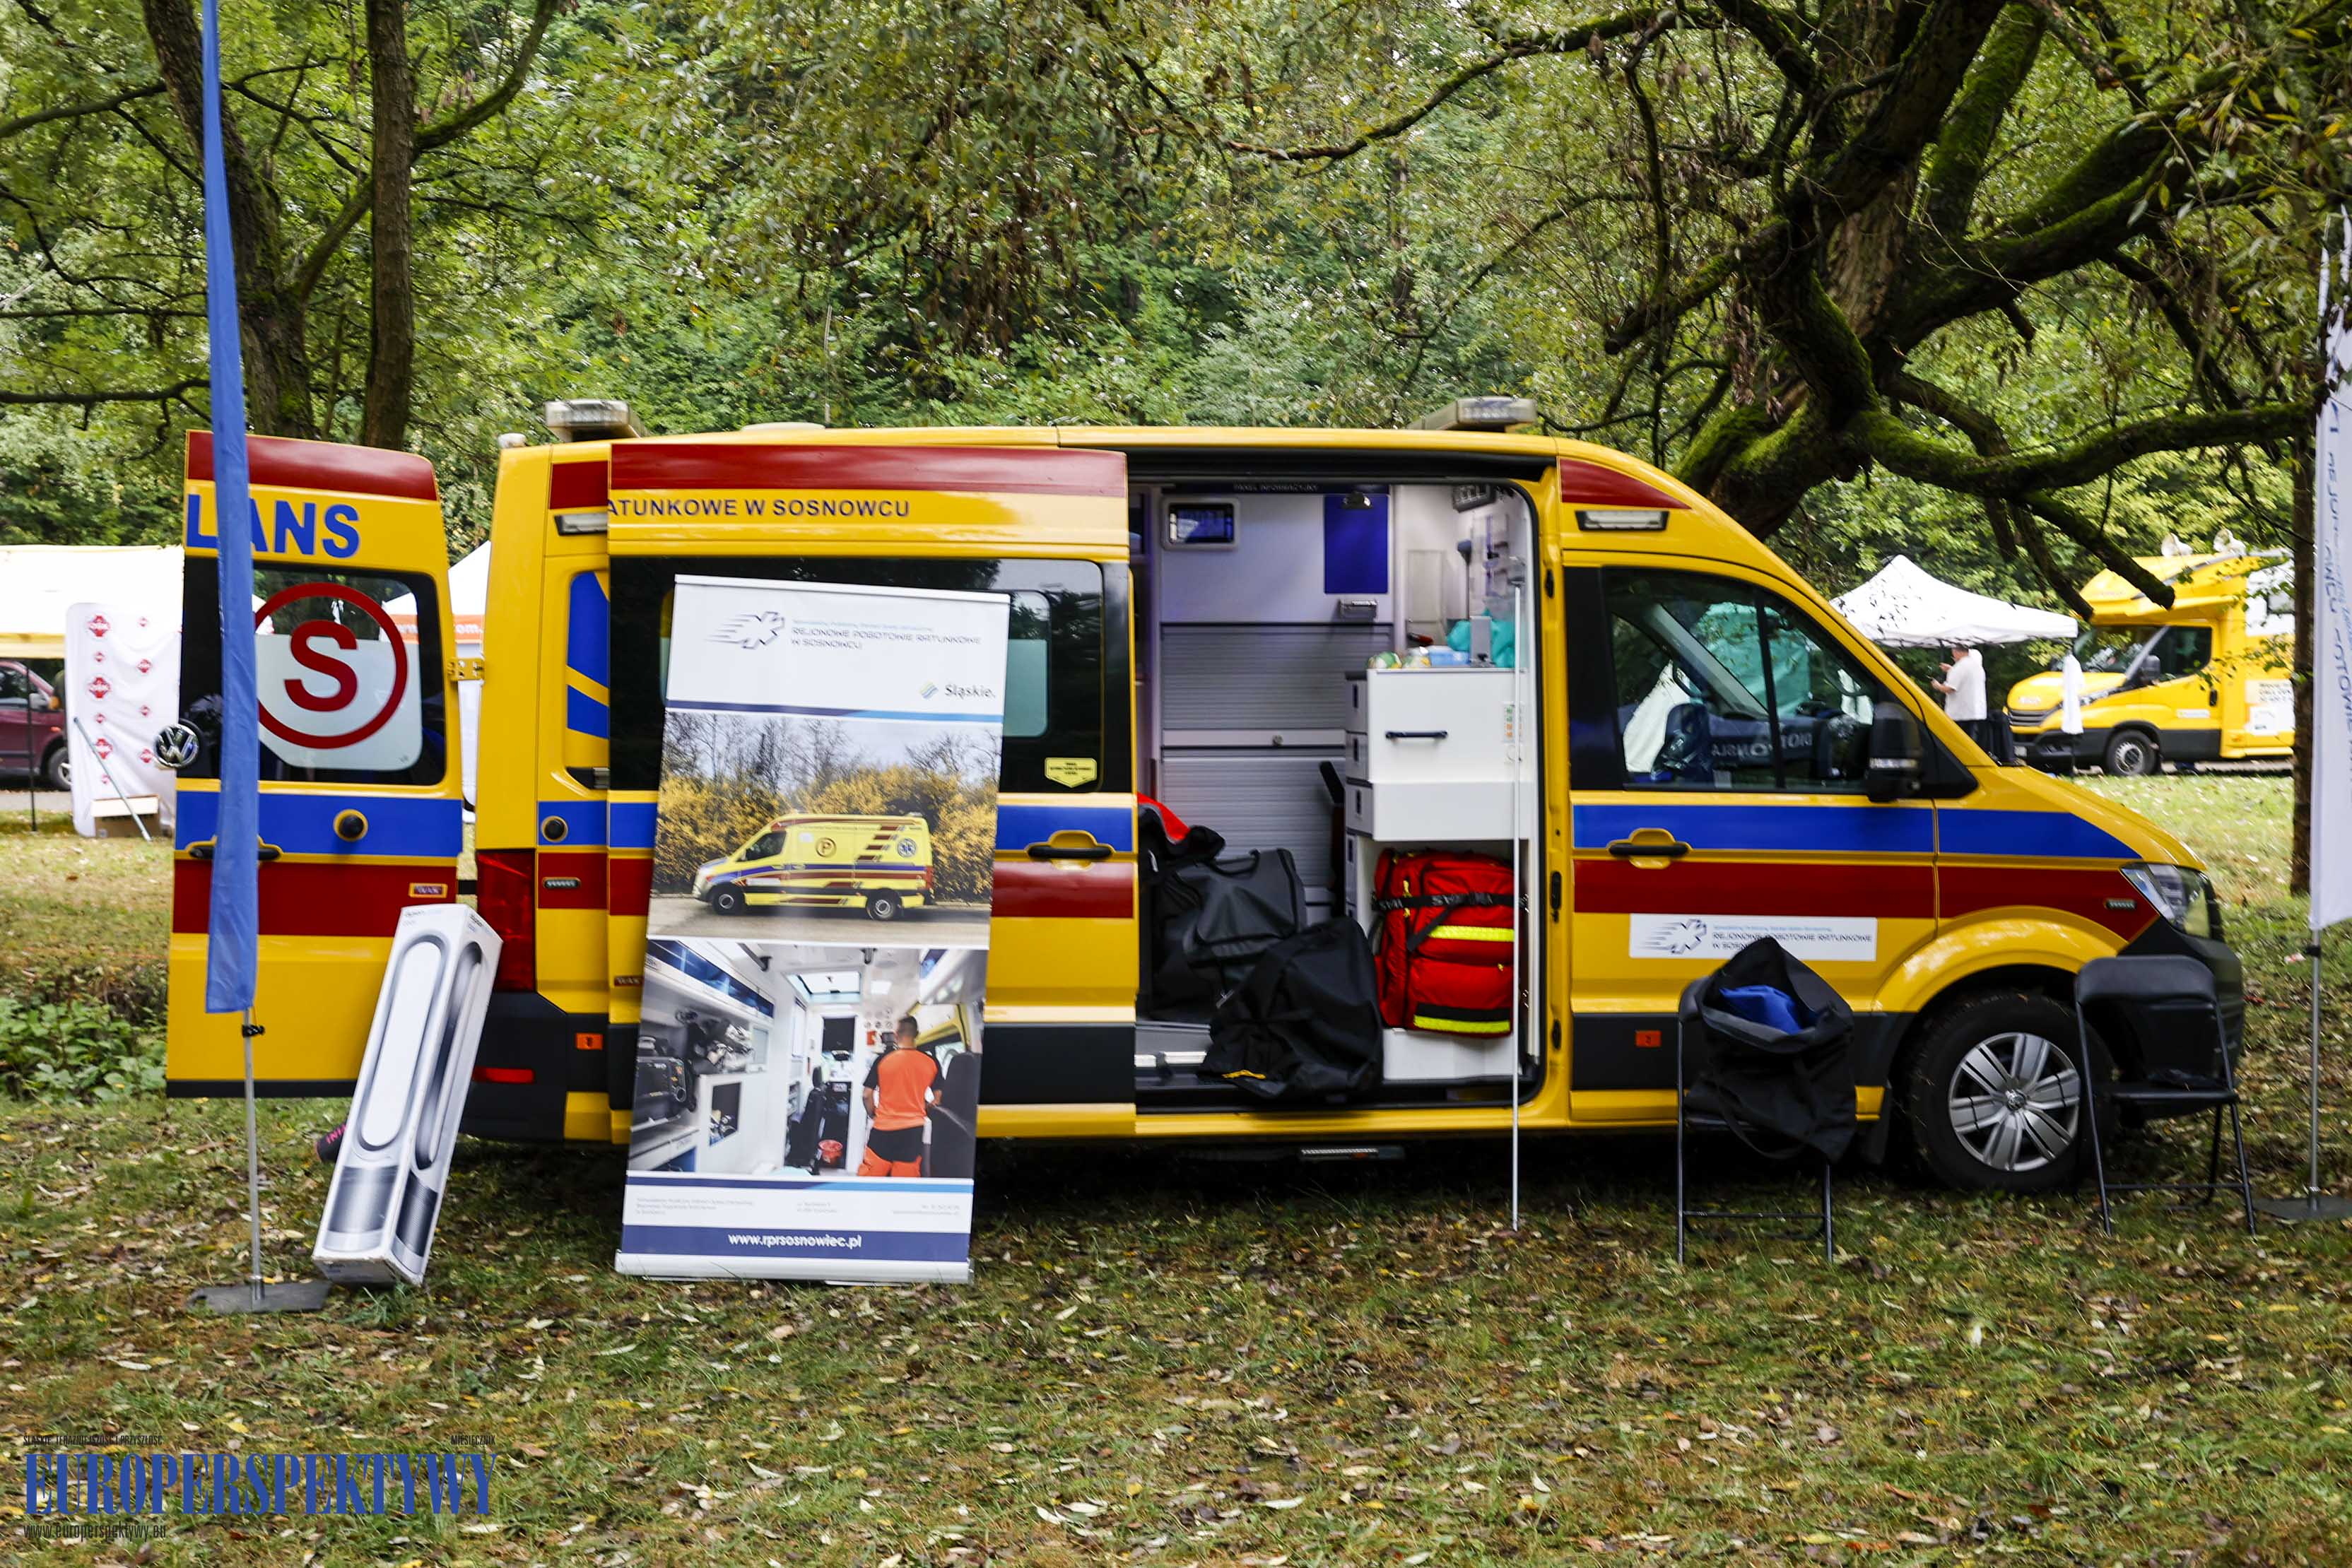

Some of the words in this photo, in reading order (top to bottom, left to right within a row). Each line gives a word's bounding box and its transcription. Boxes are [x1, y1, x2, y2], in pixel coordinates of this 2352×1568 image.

[745, 499, 766, 515] W
[773, 500, 910, 517] SOSNOWCU
[284, 619, 358, 712] S
[728, 1234, 862, 1249] www.rprsosnowiec.pl
